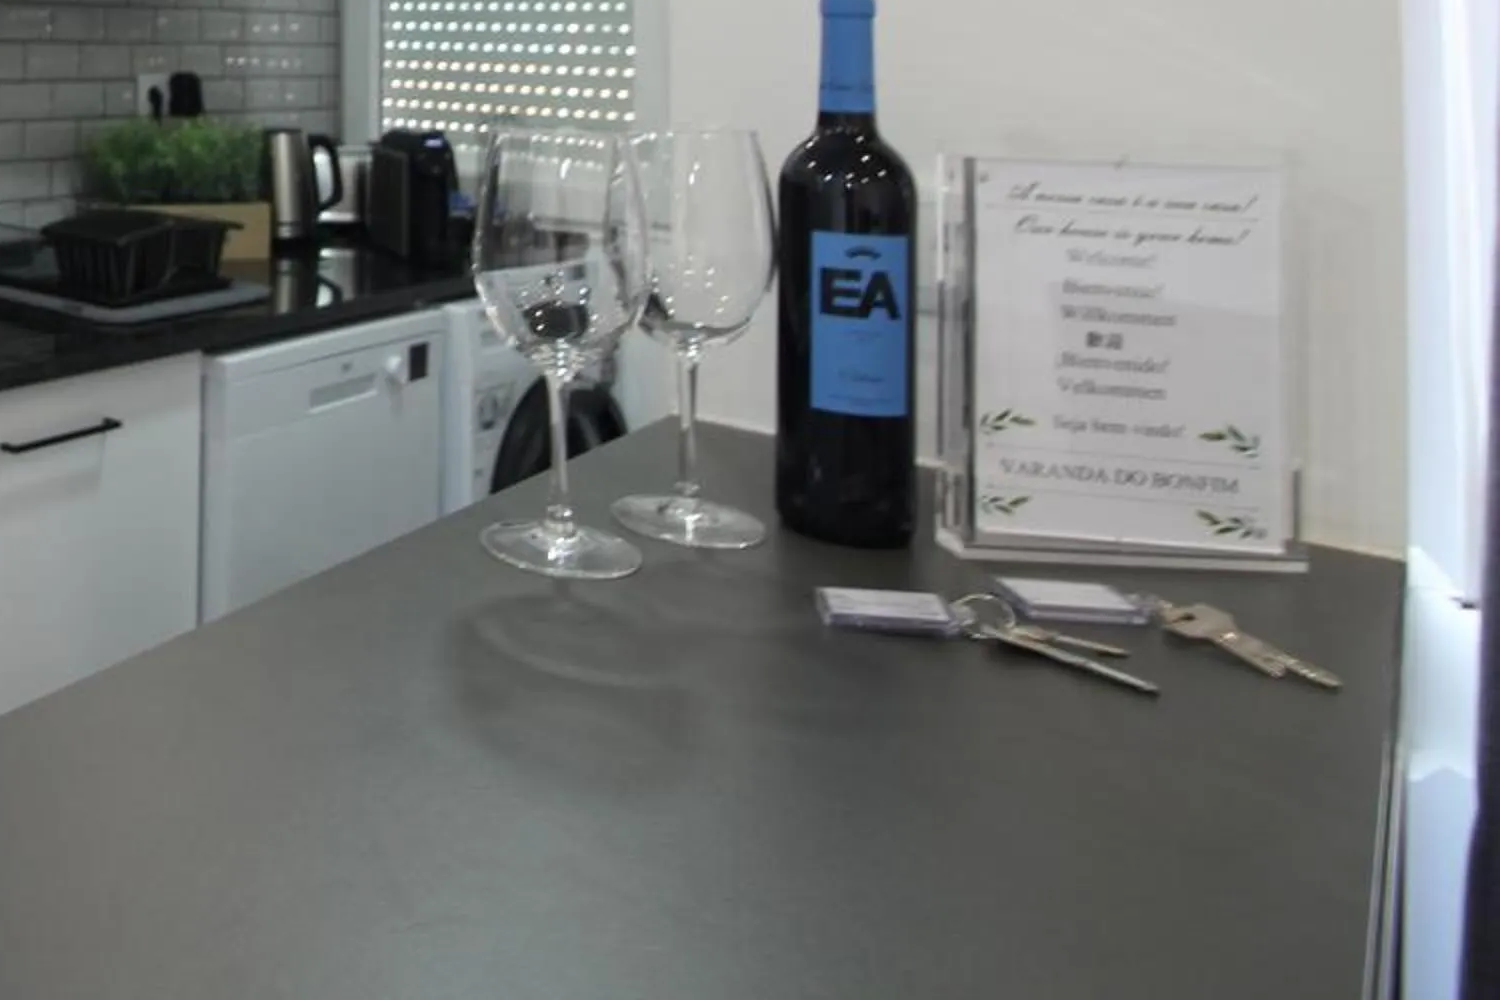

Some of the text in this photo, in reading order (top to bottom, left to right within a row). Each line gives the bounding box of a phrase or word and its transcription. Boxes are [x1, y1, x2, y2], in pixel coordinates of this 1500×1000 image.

[819, 267, 902, 320] EA
[999, 457, 1108, 485] VARANDA
[1113, 468, 1149, 486] DO
